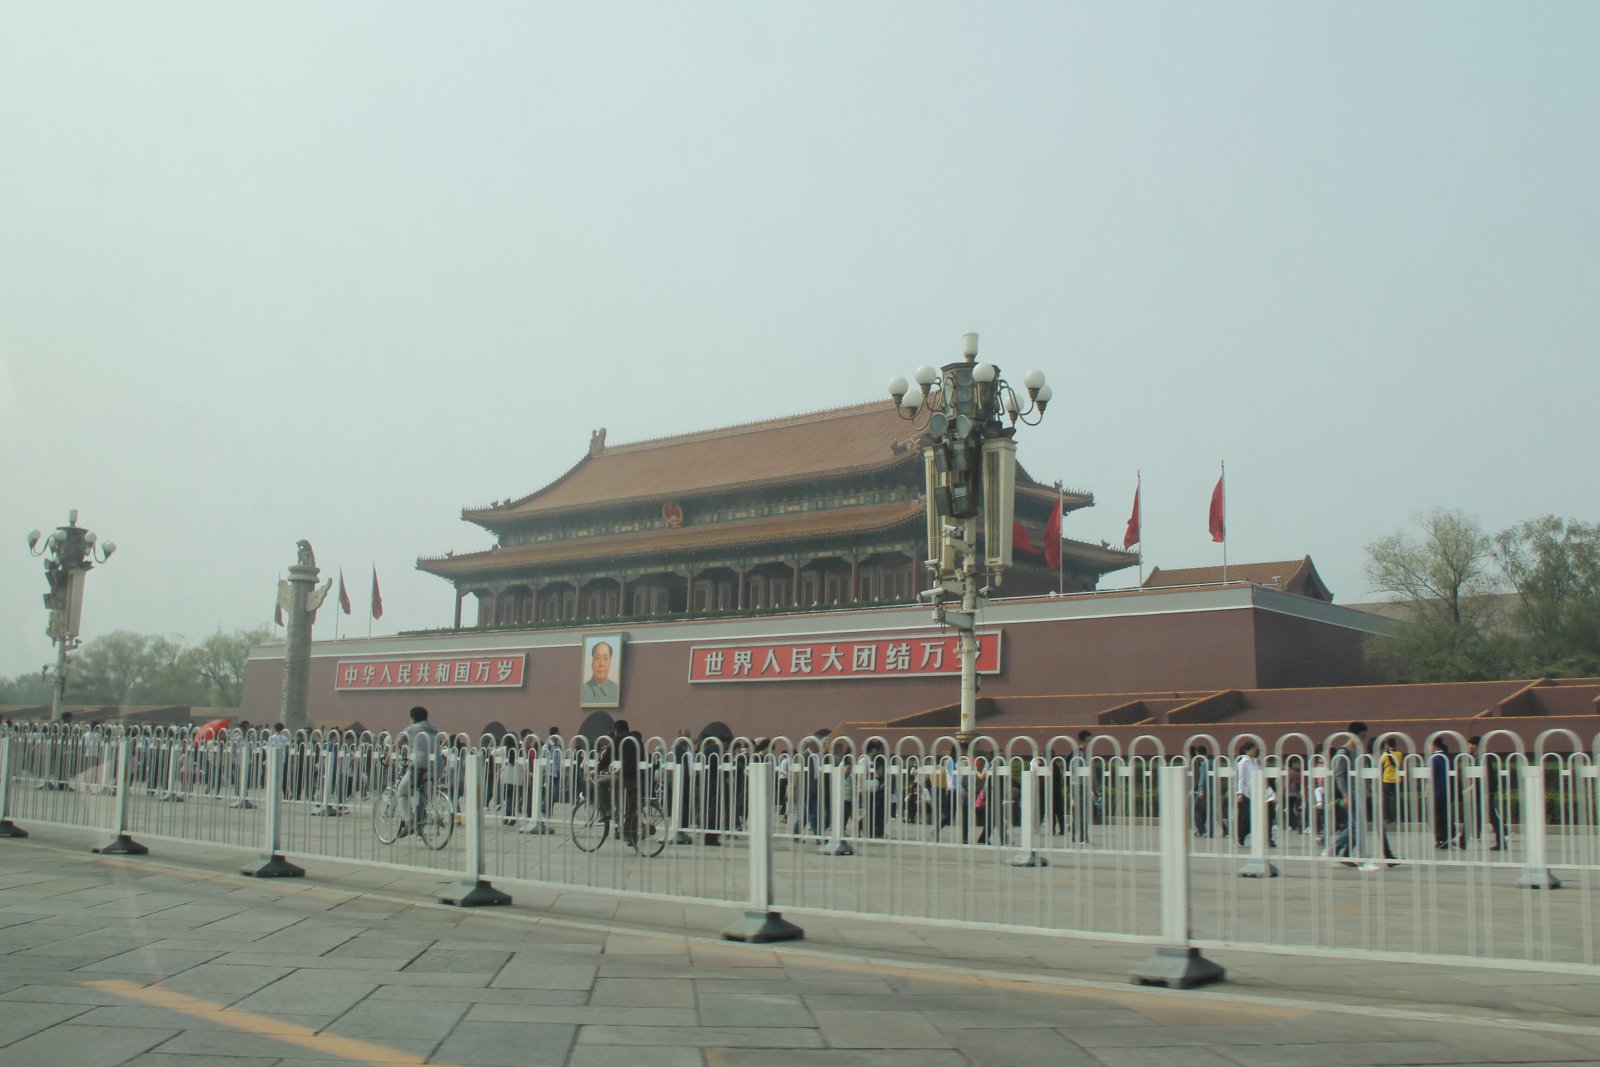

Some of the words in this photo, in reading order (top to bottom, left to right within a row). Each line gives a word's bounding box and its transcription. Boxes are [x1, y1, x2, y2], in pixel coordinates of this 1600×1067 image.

[344, 660, 513, 685] 中华人民共和国万岁
